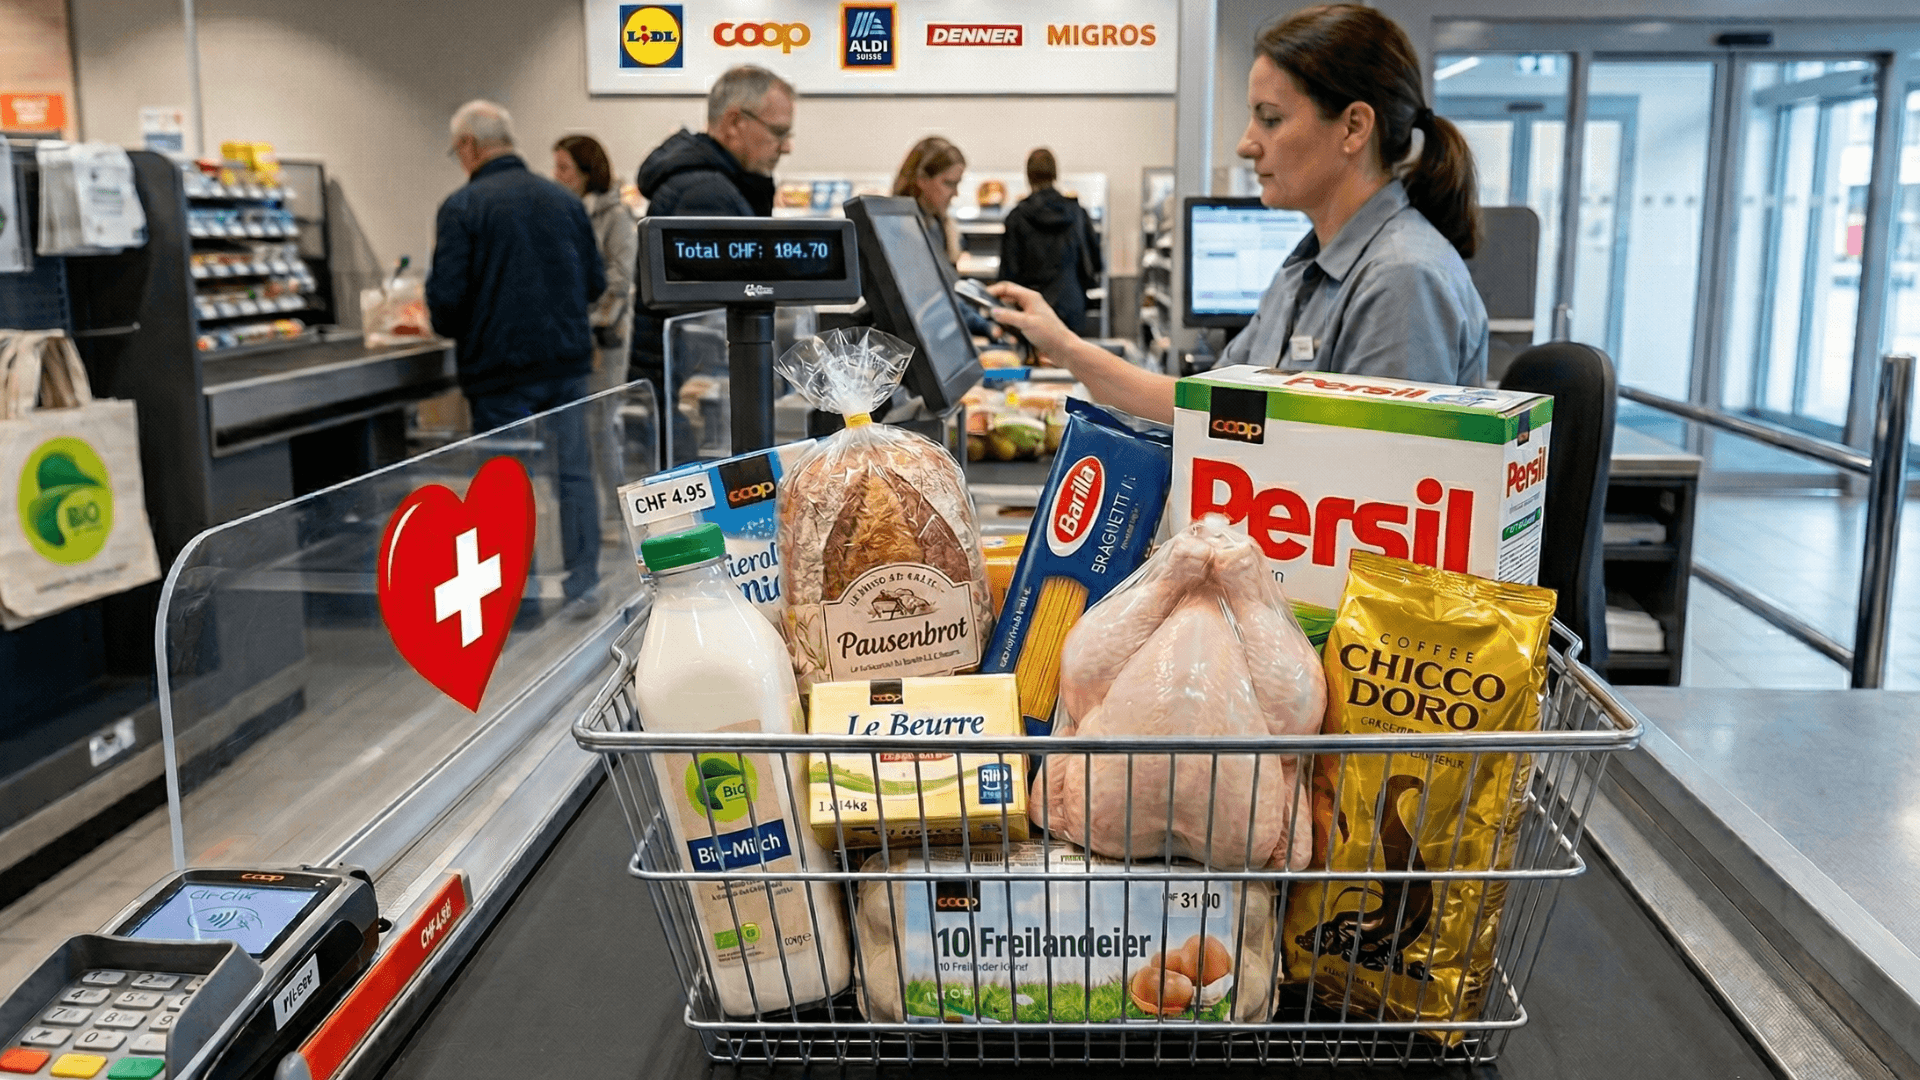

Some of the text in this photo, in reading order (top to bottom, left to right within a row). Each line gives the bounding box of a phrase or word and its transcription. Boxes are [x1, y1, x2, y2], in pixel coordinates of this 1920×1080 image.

[713, 22, 811, 54] coop
[932, 28, 1018, 44] DENNER
[1047, 24, 1156, 46] MIGROS
[849, 40, 888, 53] ALDI
[675, 242, 828, 259] Total CHF: 184.70
[1282, 377, 1430, 399] Persil
[1212, 419, 1262, 440] coop
[1506, 446, 1547, 499] Persil
[635, 483, 707, 514] CHF 4.95
[728, 481, 775, 503] coop
[1057, 465, 1097, 538] Barilla
[1191, 458, 1474, 573] Persil
[836, 617, 969, 659] Pausenbrot
[1380, 633, 1475, 665] COFFEE
[1339, 643, 1506, 702] CHICCO
[1346, 677, 1479, 731] D'ORO
[847, 713, 984, 736] Le Beurre
[937, 897, 978, 911] coop
[937, 926, 1151, 958] 10 Freilandeier
[939, 962, 950, 972] 10
[139, 974, 155, 984] 2
[70, 989, 86, 1000] 4
[122, 992, 137, 1002] 5
[52, 1007, 67, 1019] 7
[104, 1012, 119, 1023] 8
[159, 1015, 174, 1025] 9
